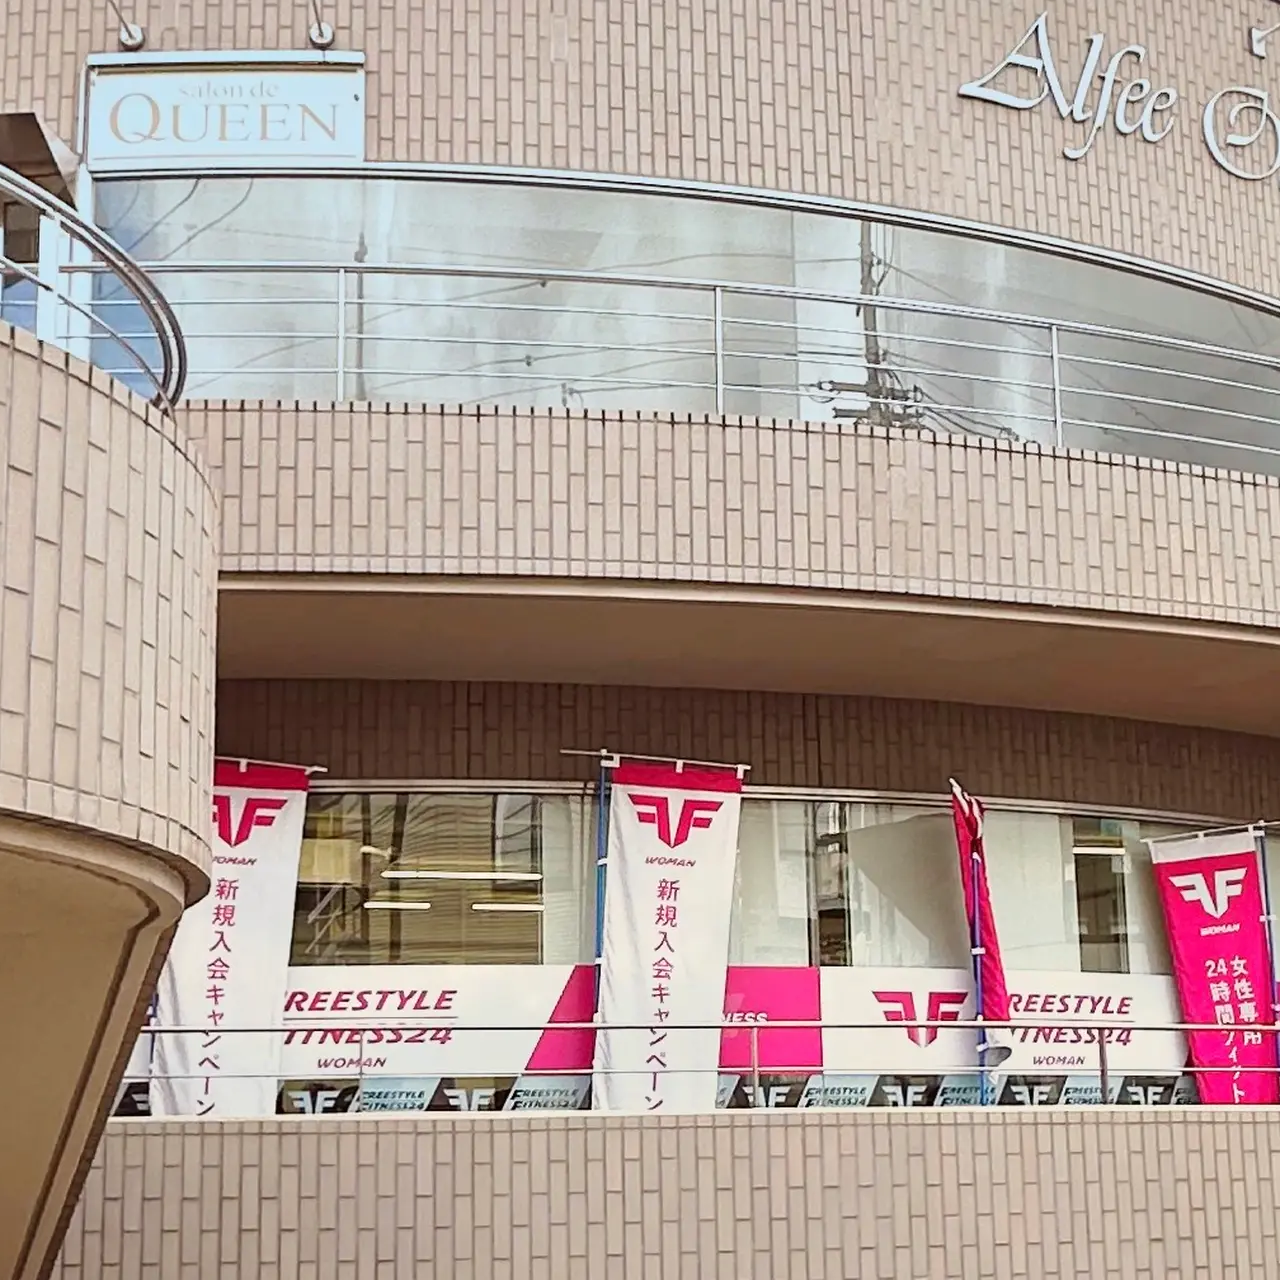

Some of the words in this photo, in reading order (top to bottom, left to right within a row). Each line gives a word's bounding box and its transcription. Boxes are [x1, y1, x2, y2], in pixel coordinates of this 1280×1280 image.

[958, 11, 1179, 160] Alfee
[109, 92, 338, 145] QUEEN
[645, 855, 697, 868] WOMAN
[196, 877, 240, 1117] 新規入会キャンペーン
[283, 989, 458, 1013] REESTYLE
[644, 877, 681, 1112] 新規入会キャンペーン
[1009, 993, 1134, 1015] REESTYLE
[317, 1057, 387, 1069] WOMAN
[1033, 1055, 1086, 1066] WOMAN
